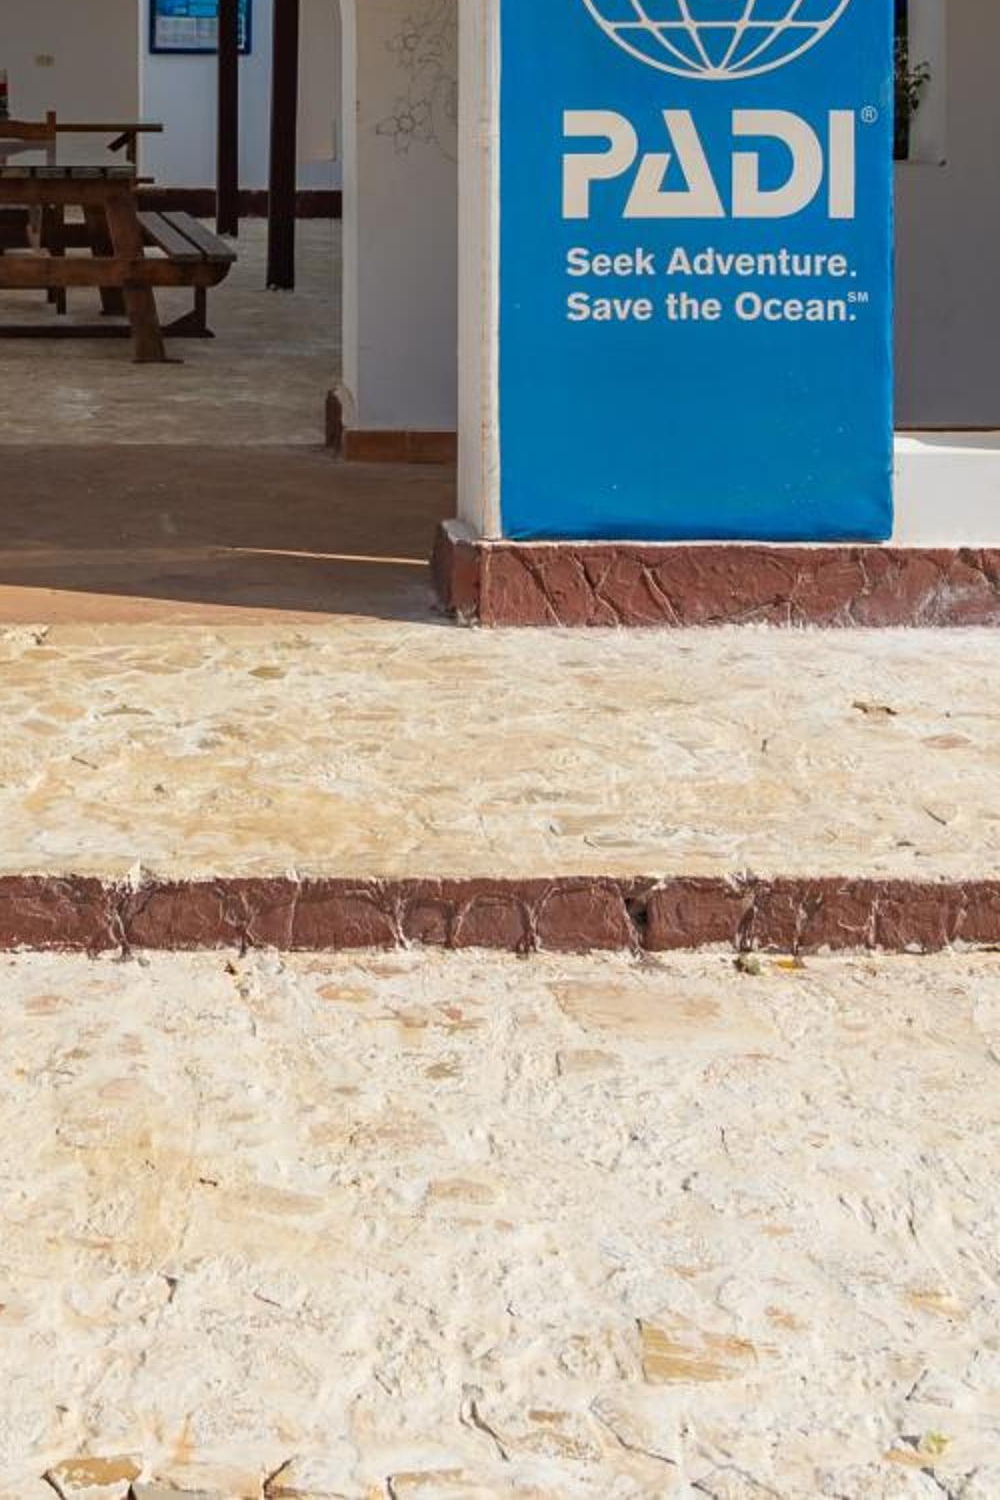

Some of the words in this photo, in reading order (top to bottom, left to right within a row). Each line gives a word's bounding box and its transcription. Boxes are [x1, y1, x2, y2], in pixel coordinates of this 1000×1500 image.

[566, 247, 655, 277] Seek
[666, 247, 857, 277] Adventure.
[566, 291, 653, 321] Save
[665, 291, 722, 321] the
